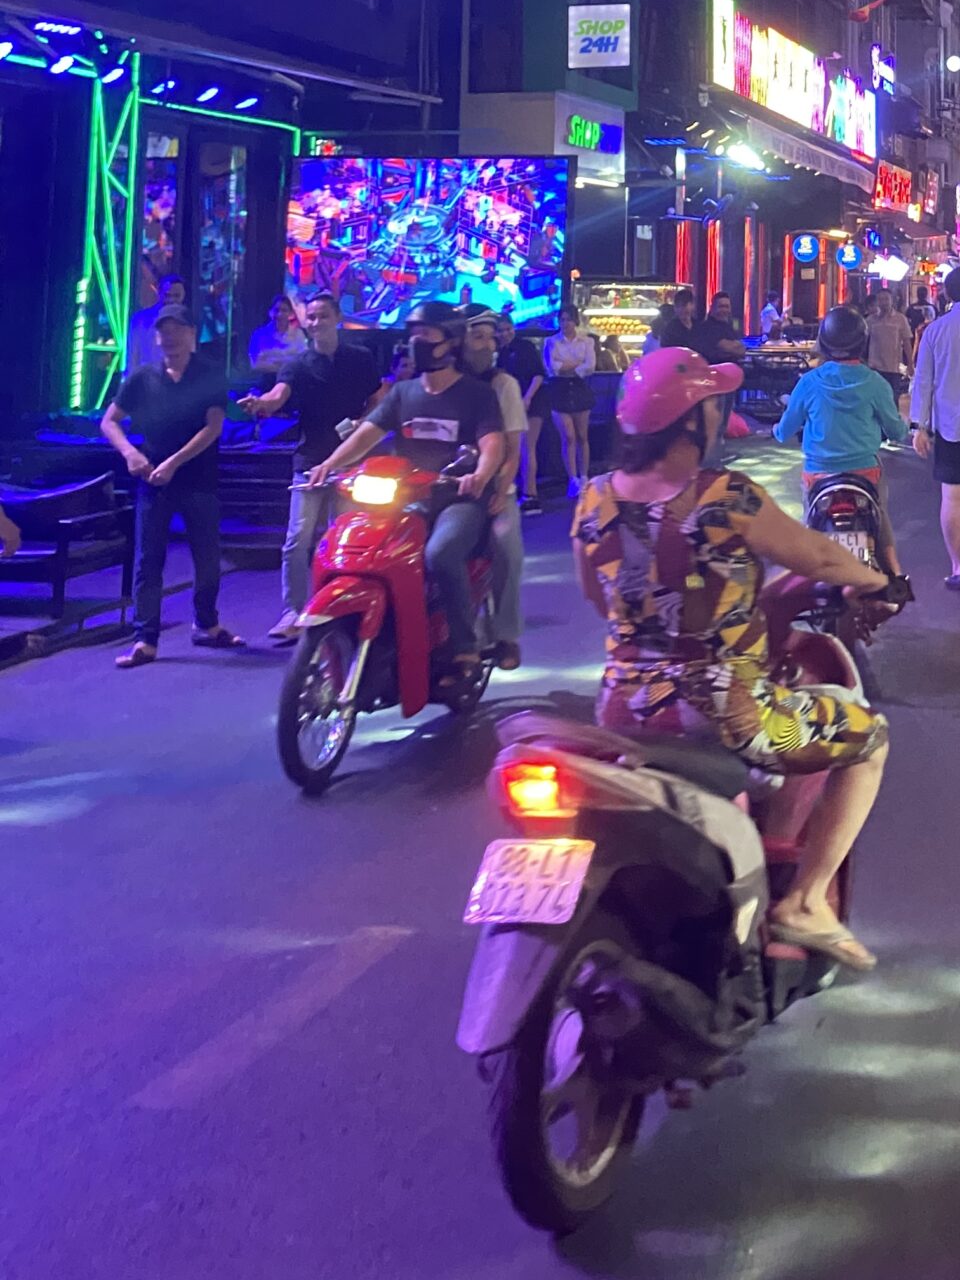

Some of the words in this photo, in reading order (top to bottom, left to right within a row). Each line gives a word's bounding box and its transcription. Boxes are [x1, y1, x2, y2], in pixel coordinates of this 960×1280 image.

[574, 19, 626, 37] SHOP
[578, 35, 619, 55] 24H
[567, 114, 601, 150] SHOP
